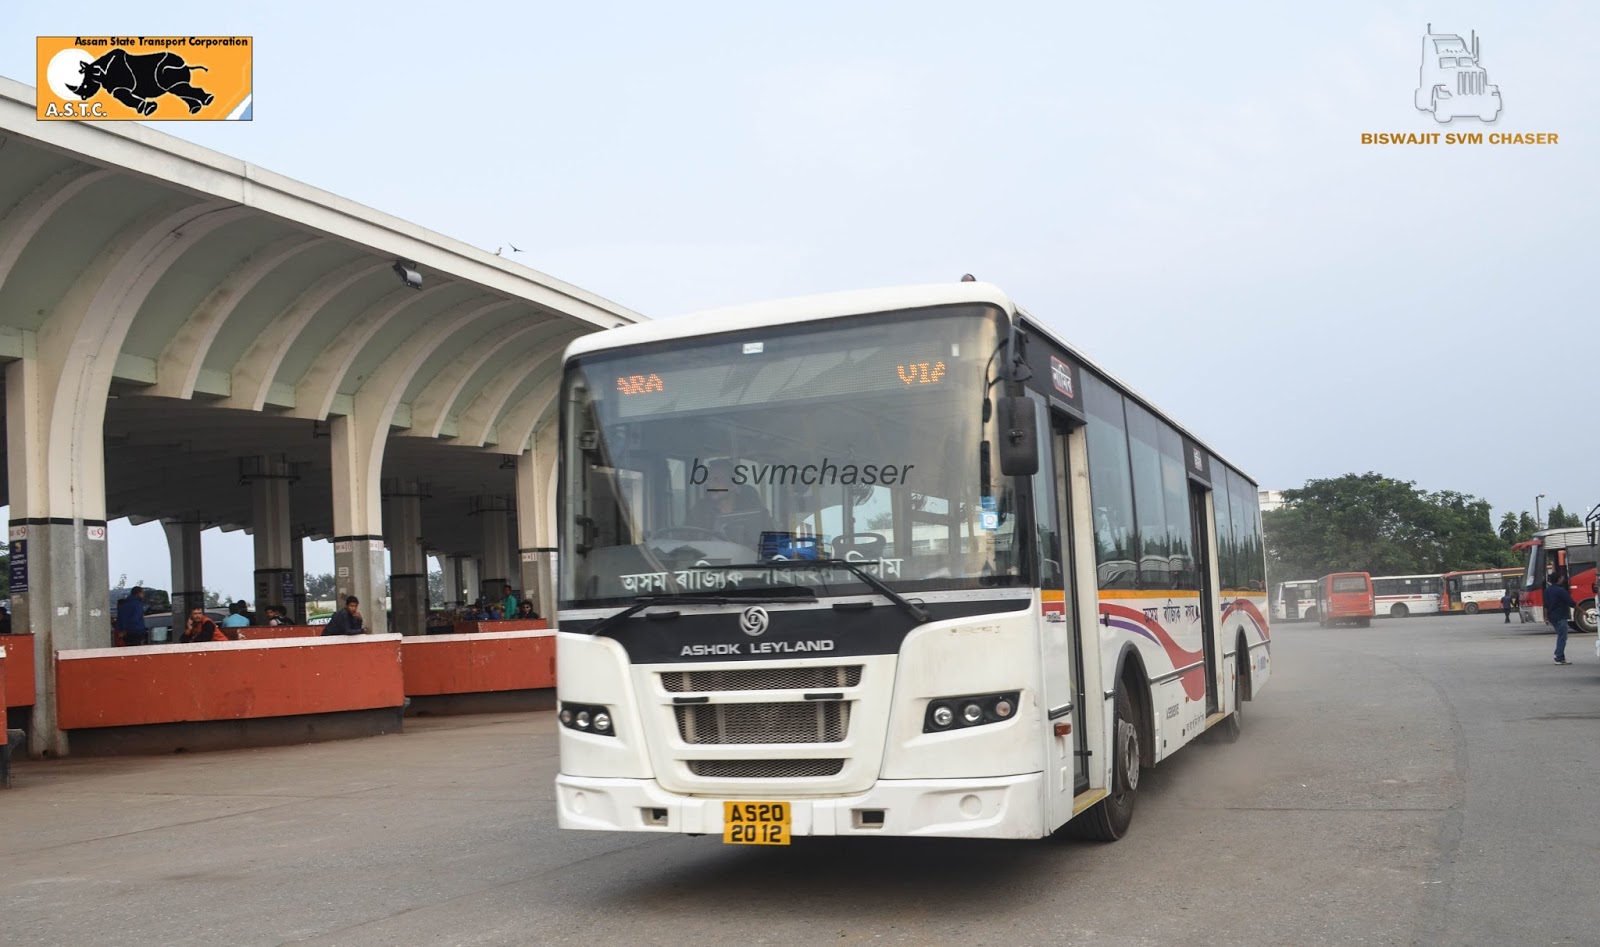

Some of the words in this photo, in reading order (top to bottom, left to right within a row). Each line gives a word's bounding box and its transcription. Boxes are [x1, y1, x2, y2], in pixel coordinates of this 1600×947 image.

[619, 572, 669, 592] অসম
[681, 643, 741, 655] ASHOK
[750, 640, 834, 653] LEYLAND
[731, 804, 784, 822] AS20
[731, 824, 782, 842] 2012
